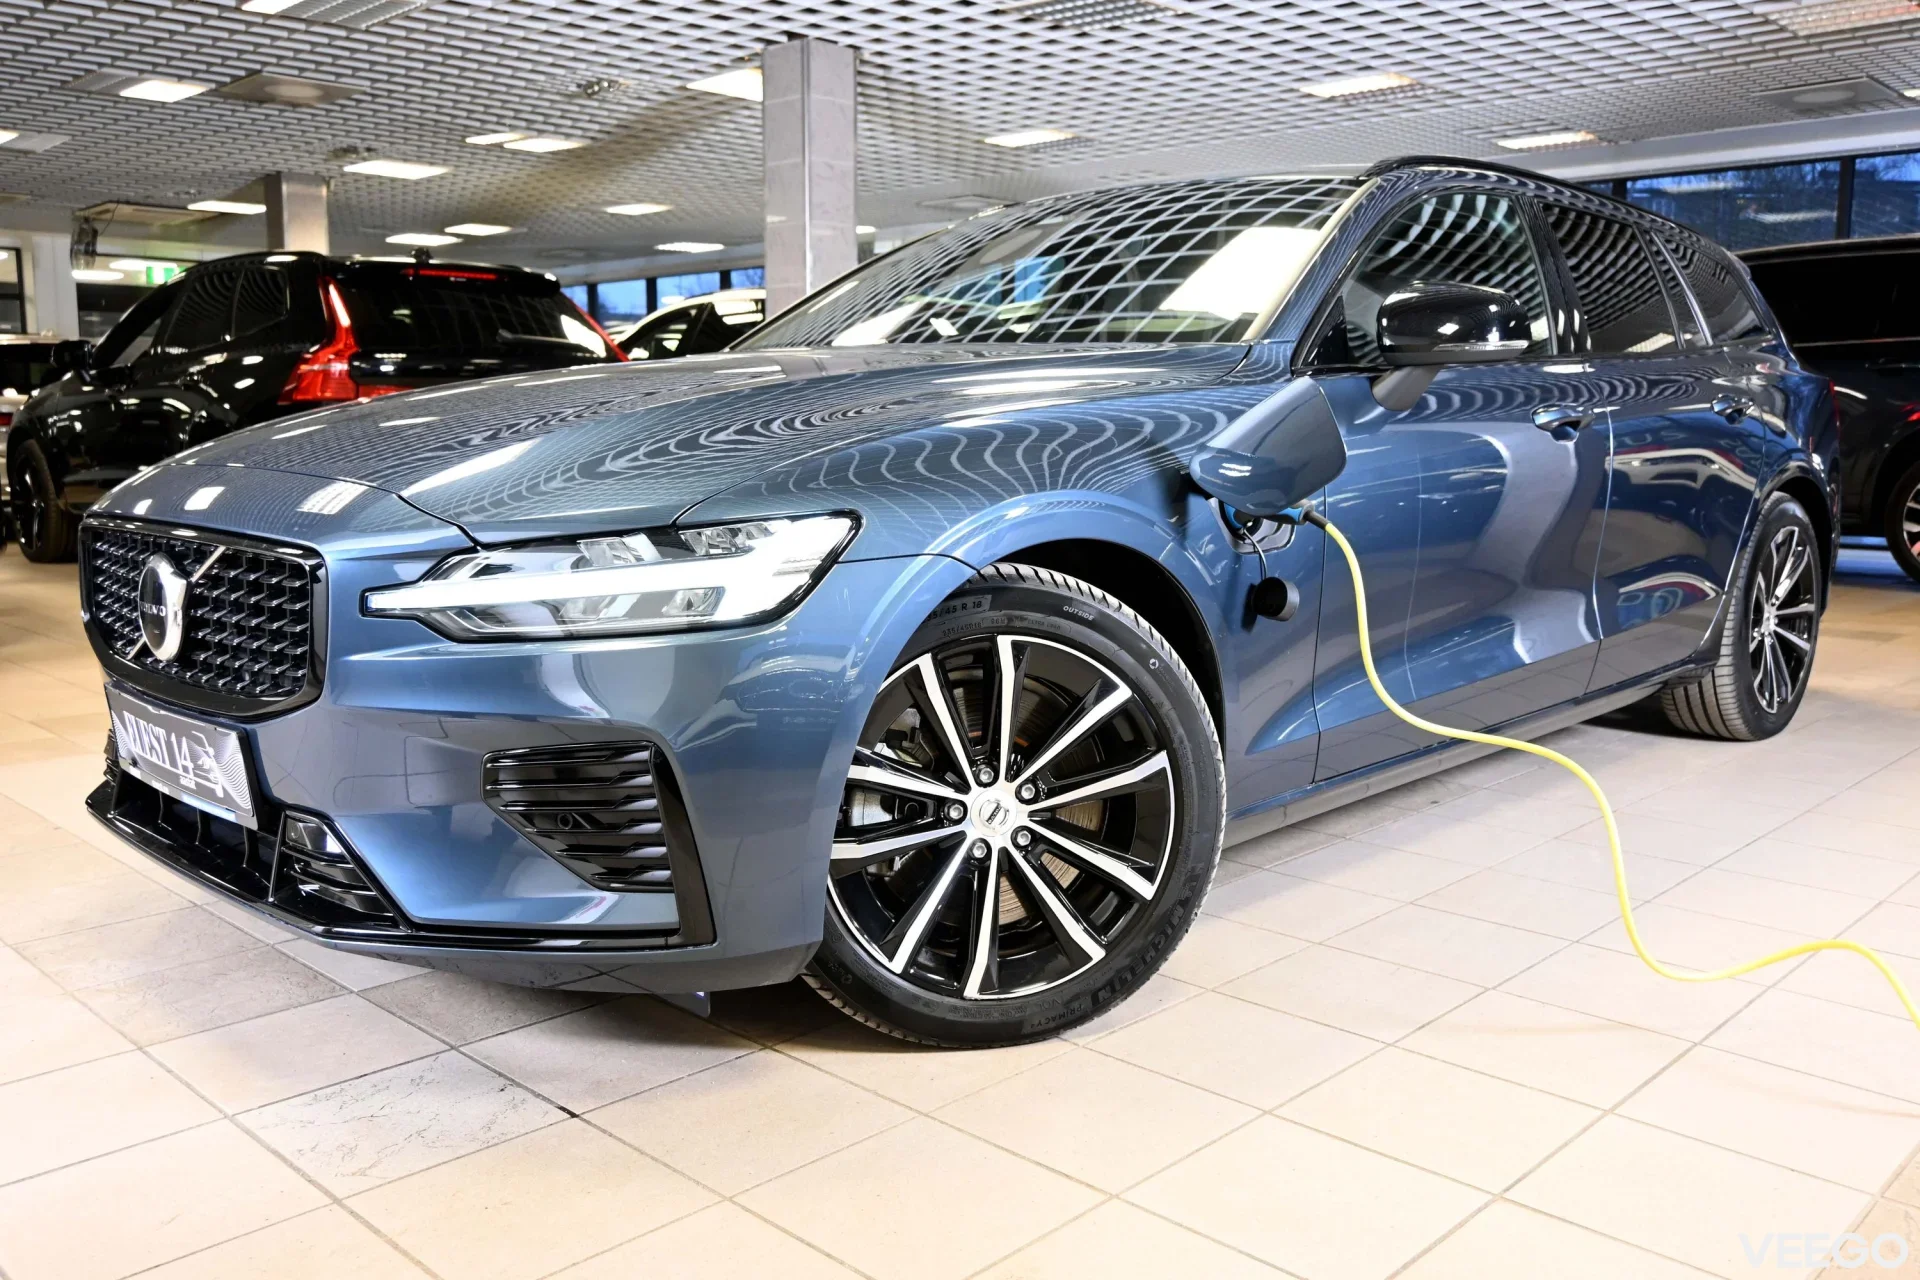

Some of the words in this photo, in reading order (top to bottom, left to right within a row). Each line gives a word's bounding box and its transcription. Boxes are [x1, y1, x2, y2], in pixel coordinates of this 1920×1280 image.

[961, 603, 968, 611] R
[972, 600, 982, 609] 18
[1062, 605, 1095, 621] OUTSIDE
[170, 731, 194, 778] 14
[1097, 904, 1185, 1003] MICHELIN
[1037, 1003, 1084, 1027] PRIMACY
